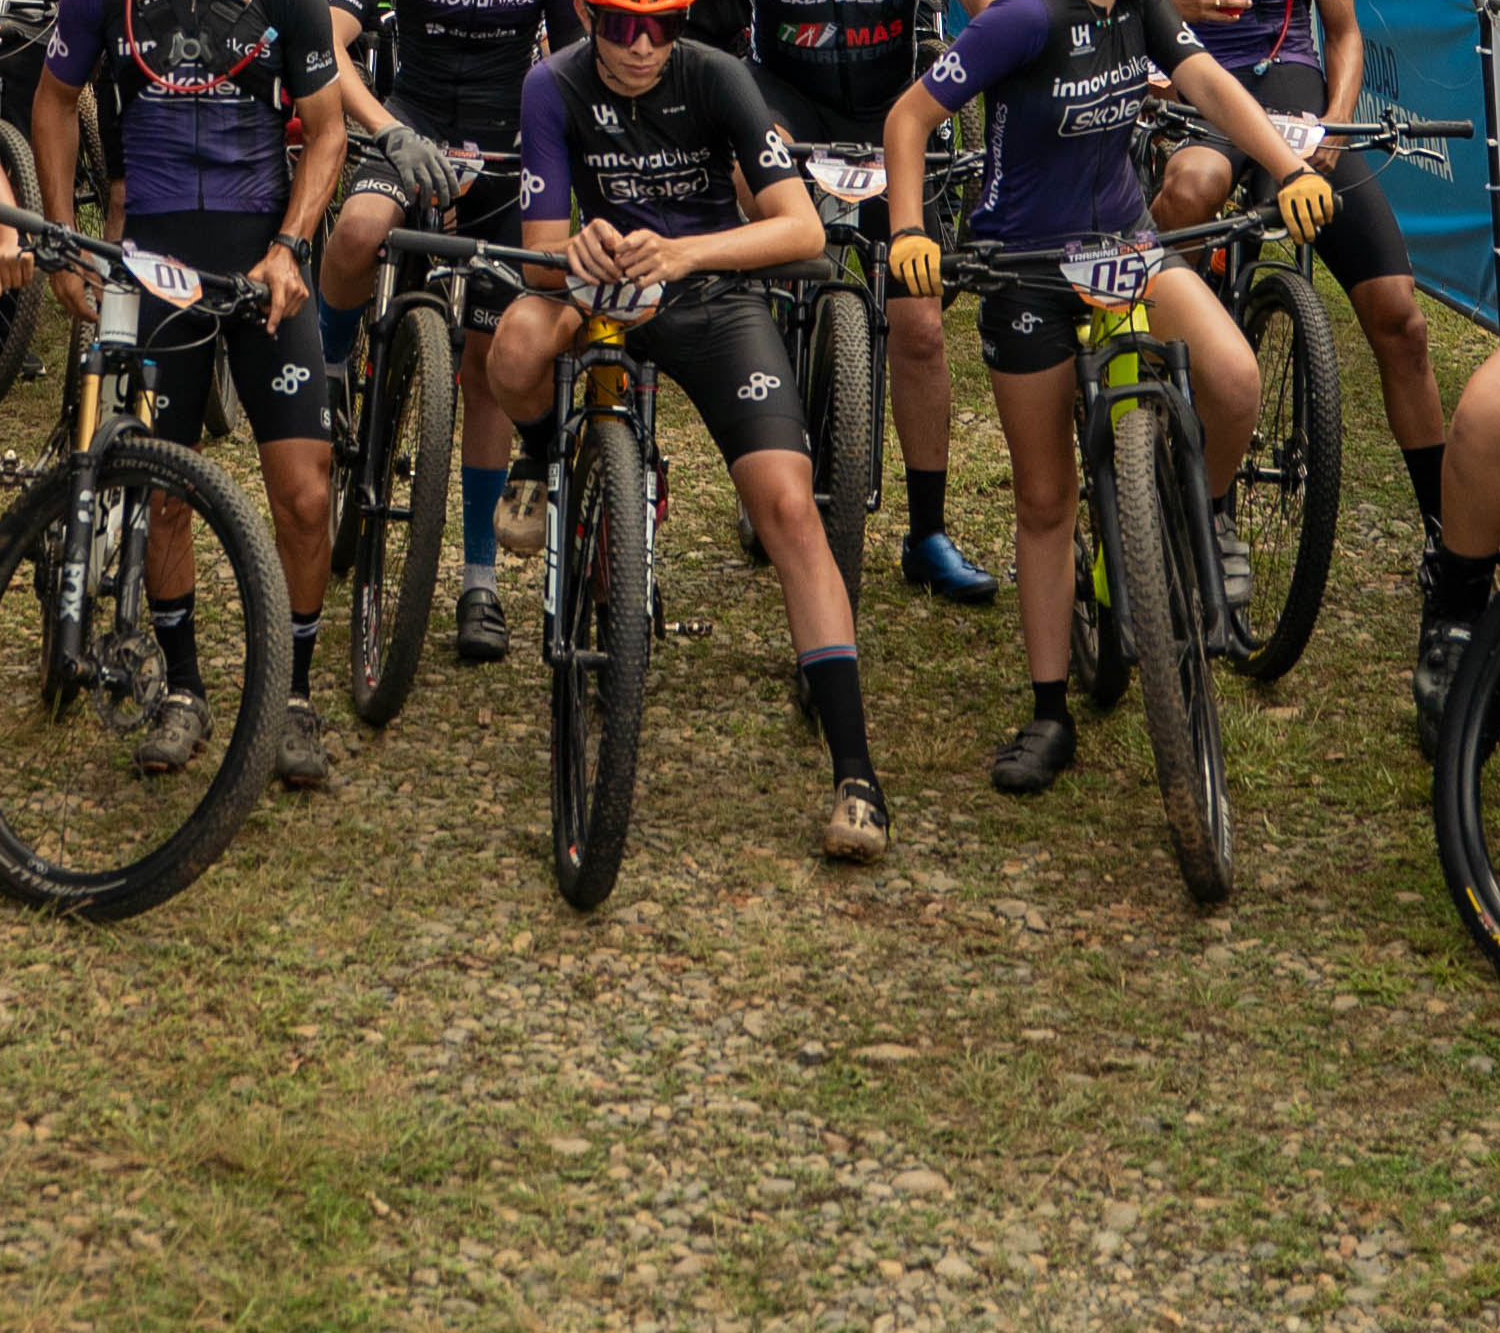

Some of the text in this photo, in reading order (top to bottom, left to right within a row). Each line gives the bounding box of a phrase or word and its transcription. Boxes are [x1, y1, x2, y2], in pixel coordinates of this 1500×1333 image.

[584, 148, 710, 170] innovabikes
[984, 103, 1008, 212] innovabikes
[836, 168, 874, 190] 10
[1069, 248, 1118, 263] TRAINING
[154, 263, 187, 291] 01
[1090, 256, 1145, 293] 05
